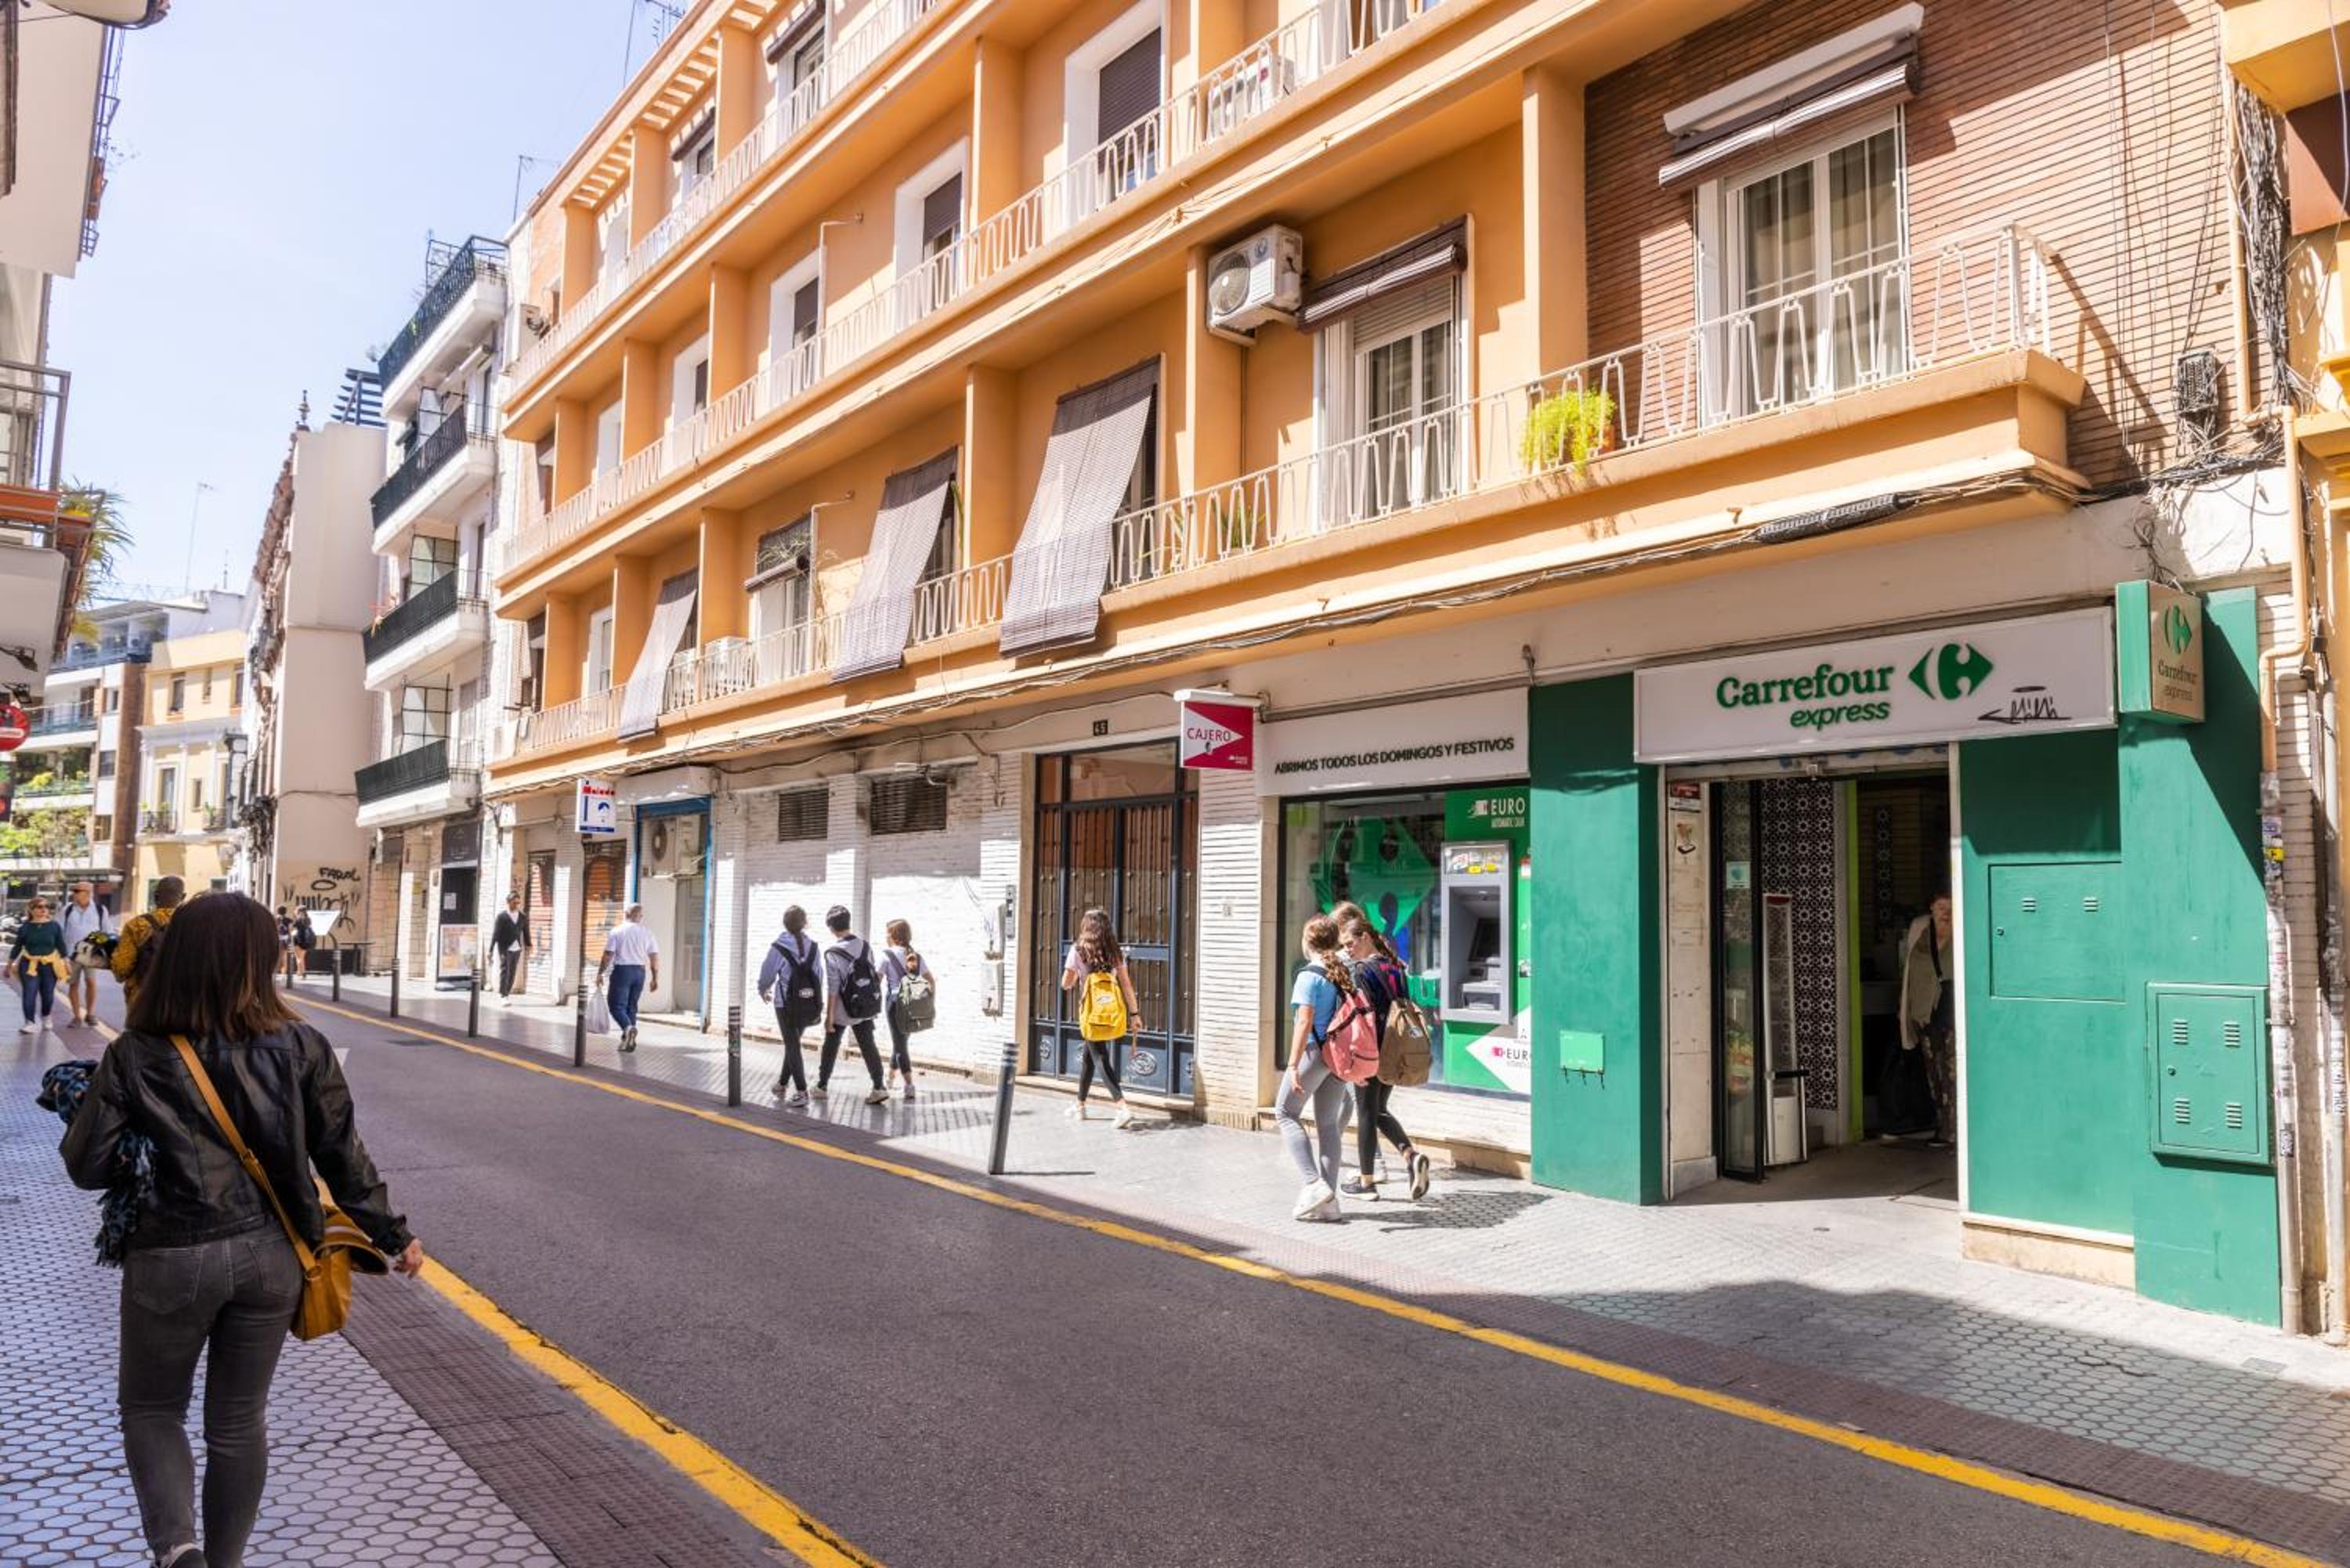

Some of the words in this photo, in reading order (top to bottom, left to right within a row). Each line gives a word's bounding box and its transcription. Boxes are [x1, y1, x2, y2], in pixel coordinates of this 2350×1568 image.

[1716, 664, 1895, 708] Carrefour
[1790, 699, 1893, 730] express
[1187, 727, 1231, 742] CAJERO
[1274, 758, 1318, 775] ABRIMOS
[1320, 755, 1357, 770] TODOS
[1358, 750, 1379, 766] LOS
[1380, 745, 1443, 764] DOMINGOS
[1444, 744, 1453, 757] Y
[1455, 737, 1514, 756] FESTIVOS
[1491, 797, 1525, 815] EURO
[1506, 1048, 1531, 1060] EUR
